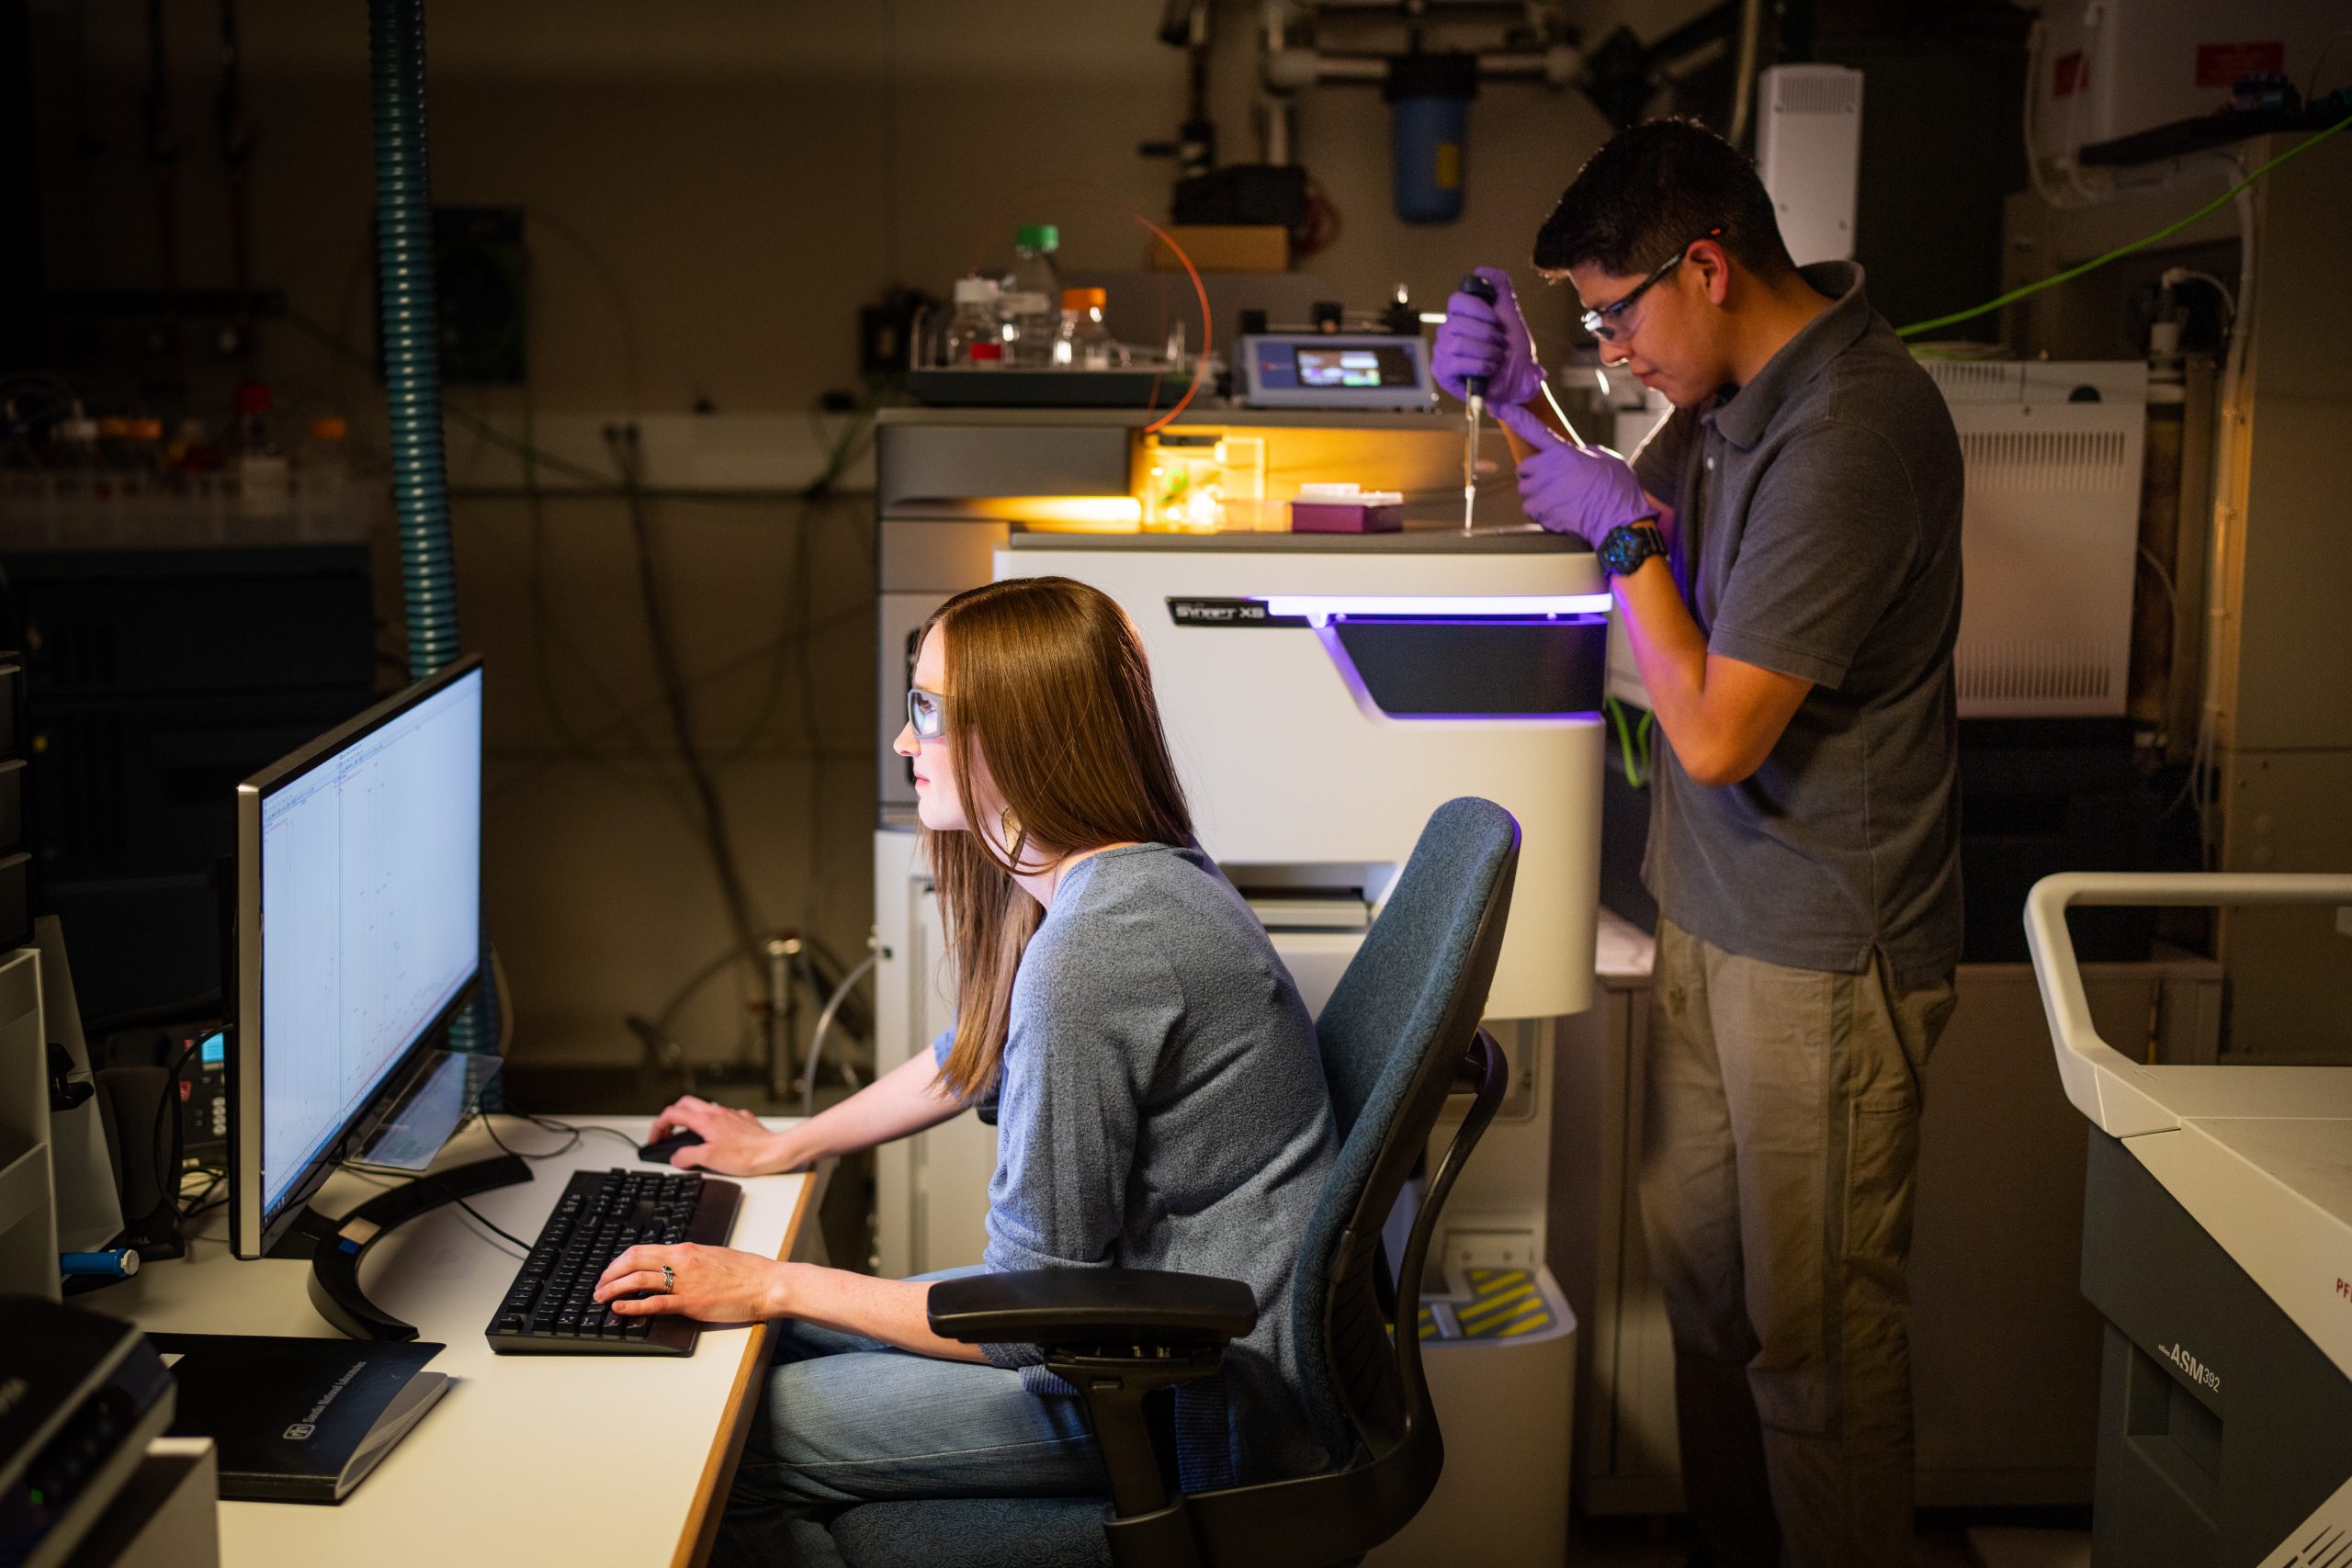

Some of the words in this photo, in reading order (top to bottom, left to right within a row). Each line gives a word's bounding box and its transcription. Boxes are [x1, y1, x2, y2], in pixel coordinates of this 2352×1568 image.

[2336, 1278, 2352, 1303] PF
[301, 1404, 326, 1423] Sandia
[317, 1385, 343, 1404] National
